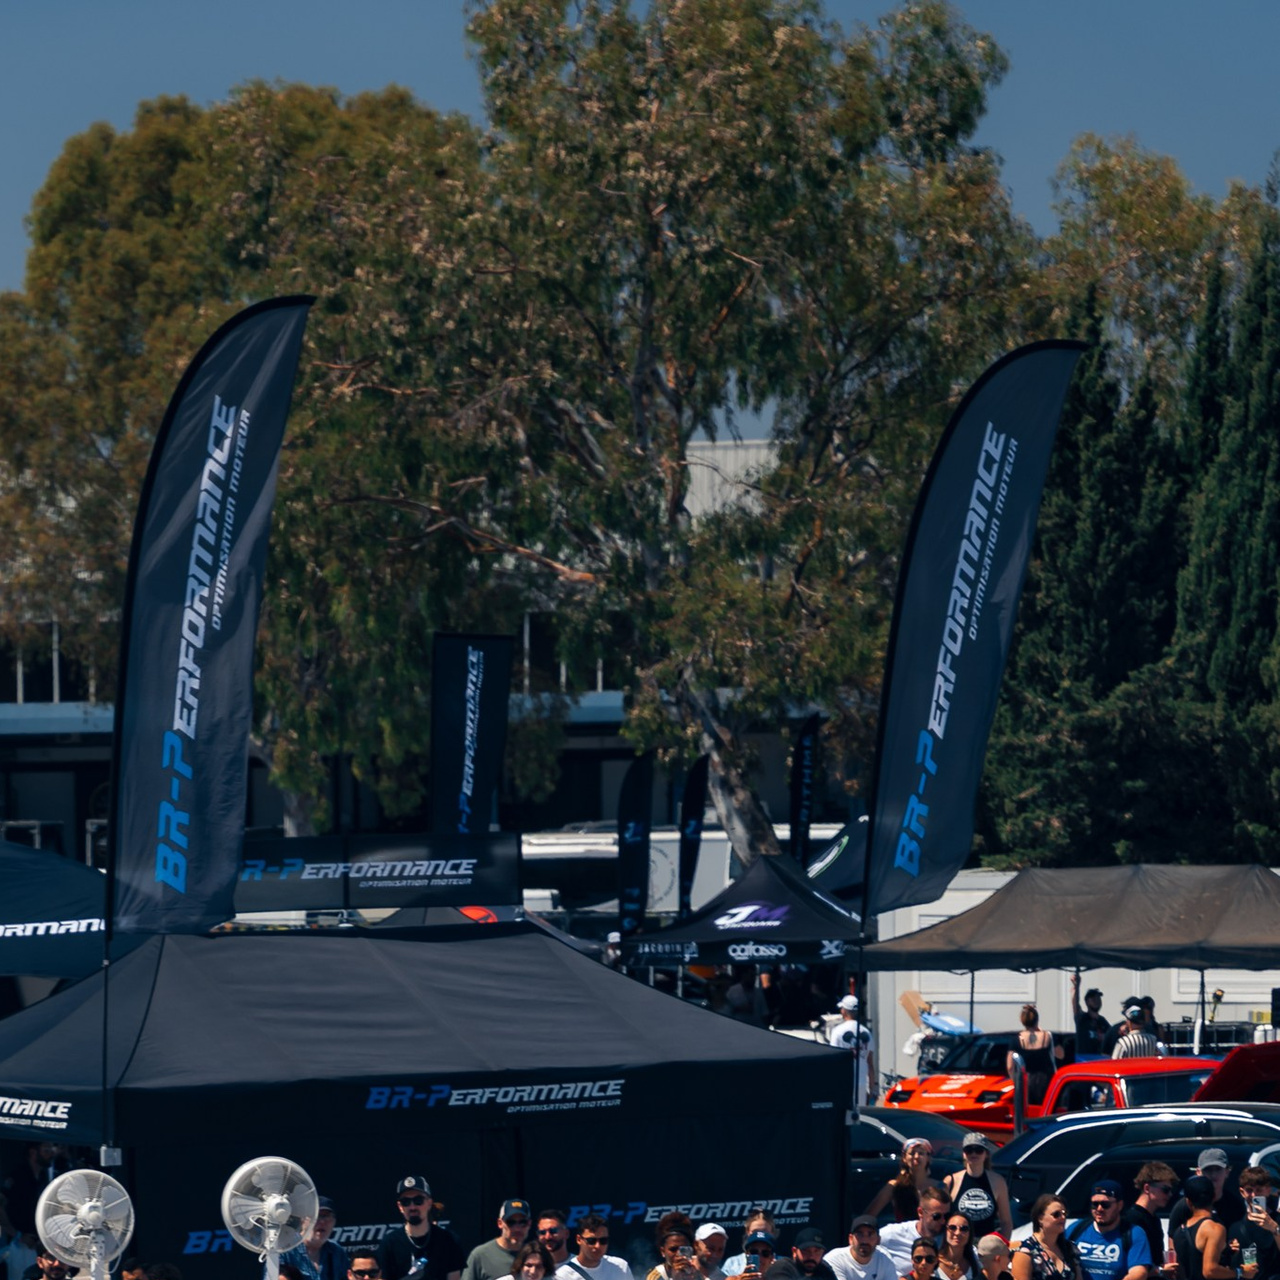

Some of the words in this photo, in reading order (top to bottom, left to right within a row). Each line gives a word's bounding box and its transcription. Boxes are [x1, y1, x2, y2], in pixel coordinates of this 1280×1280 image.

[211, 496, 236, 632] OPTIMISATION
[228, 408, 251, 494] MOTEUR
[967, 518, 1001, 641] OPTIMISATION
[994, 437, 1019, 518] MOTEUR
[240, 858, 477, 882] R-PERFORMANCE
